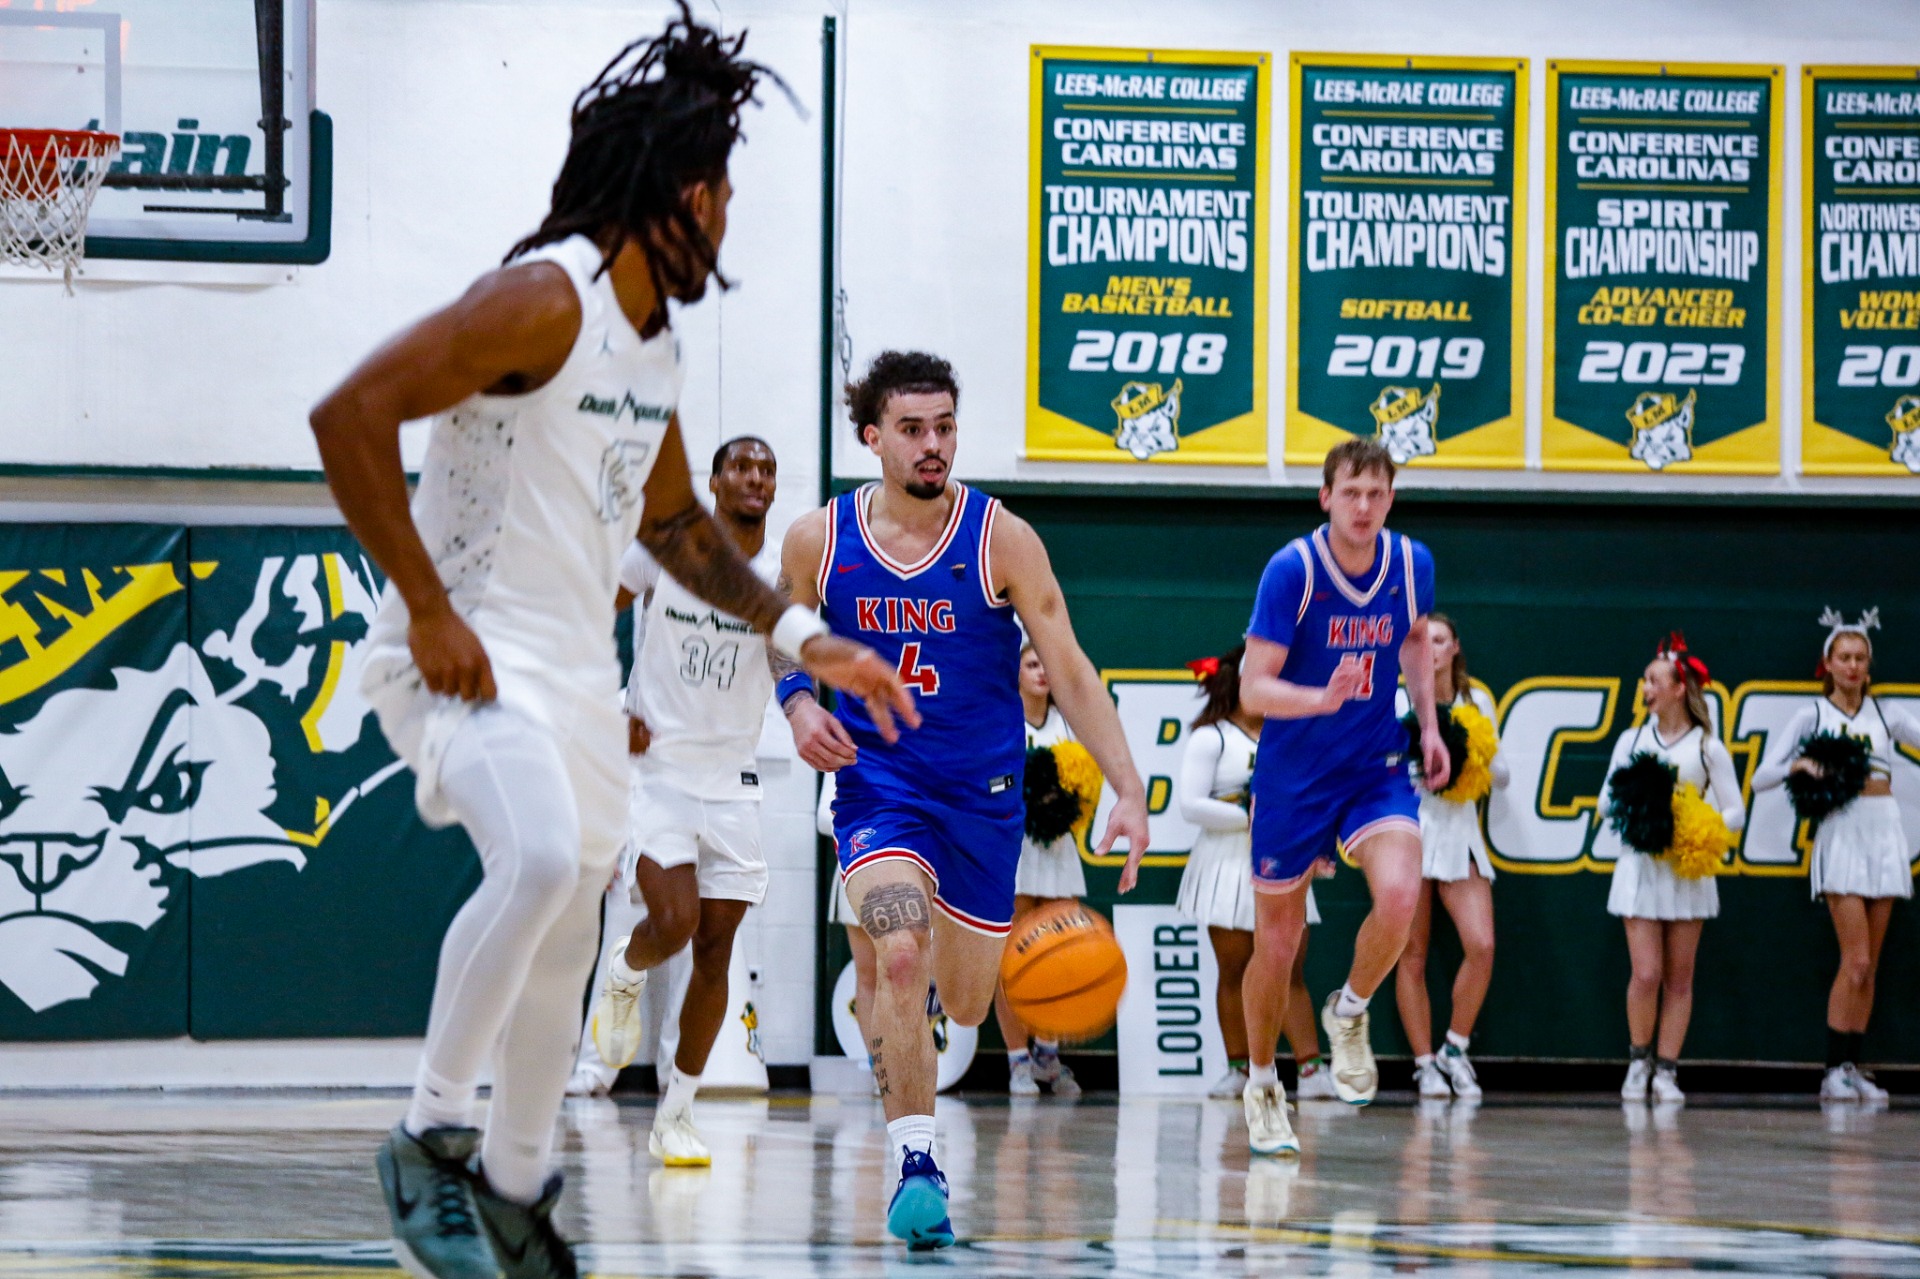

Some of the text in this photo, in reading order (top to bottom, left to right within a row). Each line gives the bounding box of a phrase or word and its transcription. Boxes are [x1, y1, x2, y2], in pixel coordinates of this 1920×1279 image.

[1054, 72, 1247, 102] LEES-McRAE COLLEGE
[1313, 78, 1505, 108] LEES-McRAE COLLEGE
[1569, 86, 1760, 114] LEES-McRAE COLLEGE
[1053, 117, 1246, 146] CONFERENCE
[1312, 123, 1504, 152] CONFERENCE
[1568, 130, 1759, 158] CONFERENCE
[1061, 142, 1238, 170] CAROLINAS
[1320, 149, 1496, 176] CAROLINAS
[1824, 135, 1920, 160] CONFE
[1576, 155, 1750, 182] CAROLINAS
[1833, 160, 1920, 184] CARO
[1045, 185, 1252, 219] TOURNAMENT
[1304, 190, 1509, 224] TOURNAMENT
[1597, 198, 1730, 229] SPIRIT
[1047, 215, 1248, 273] CHAMPIONS
[1306, 220, 1505, 277] CHAMPIONS
[1564, 226, 1759, 283] CHAMPIONSHIP
[1820, 231, 1920, 284] CHAM
[1106, 274, 1192, 299] MEN'S
[1590, 286, 1734, 309] ADVANCED
[1062, 292, 1232, 319] BASKETBALL
[1340, 298, 1472, 322] SOFTBALL
[1577, 304, 1746, 328] CO-ED CHEER
[1839, 309, 1920, 330] VOLLE
[1068, 330, 1228, 375] 2018
[1326, 335, 1486, 380] 2019
[1577, 341, 1746, 386] 2023
[1837, 345, 1920, 388] 20
[856, 597, 956, 633] KING
[1326, 612, 1394, 649] KING
[680, 634, 739, 692] 34
[898, 641, 940, 697] 4
[872, 898, 923, 932] 610
[1154, 924, 1203, 1076] LOUDER
